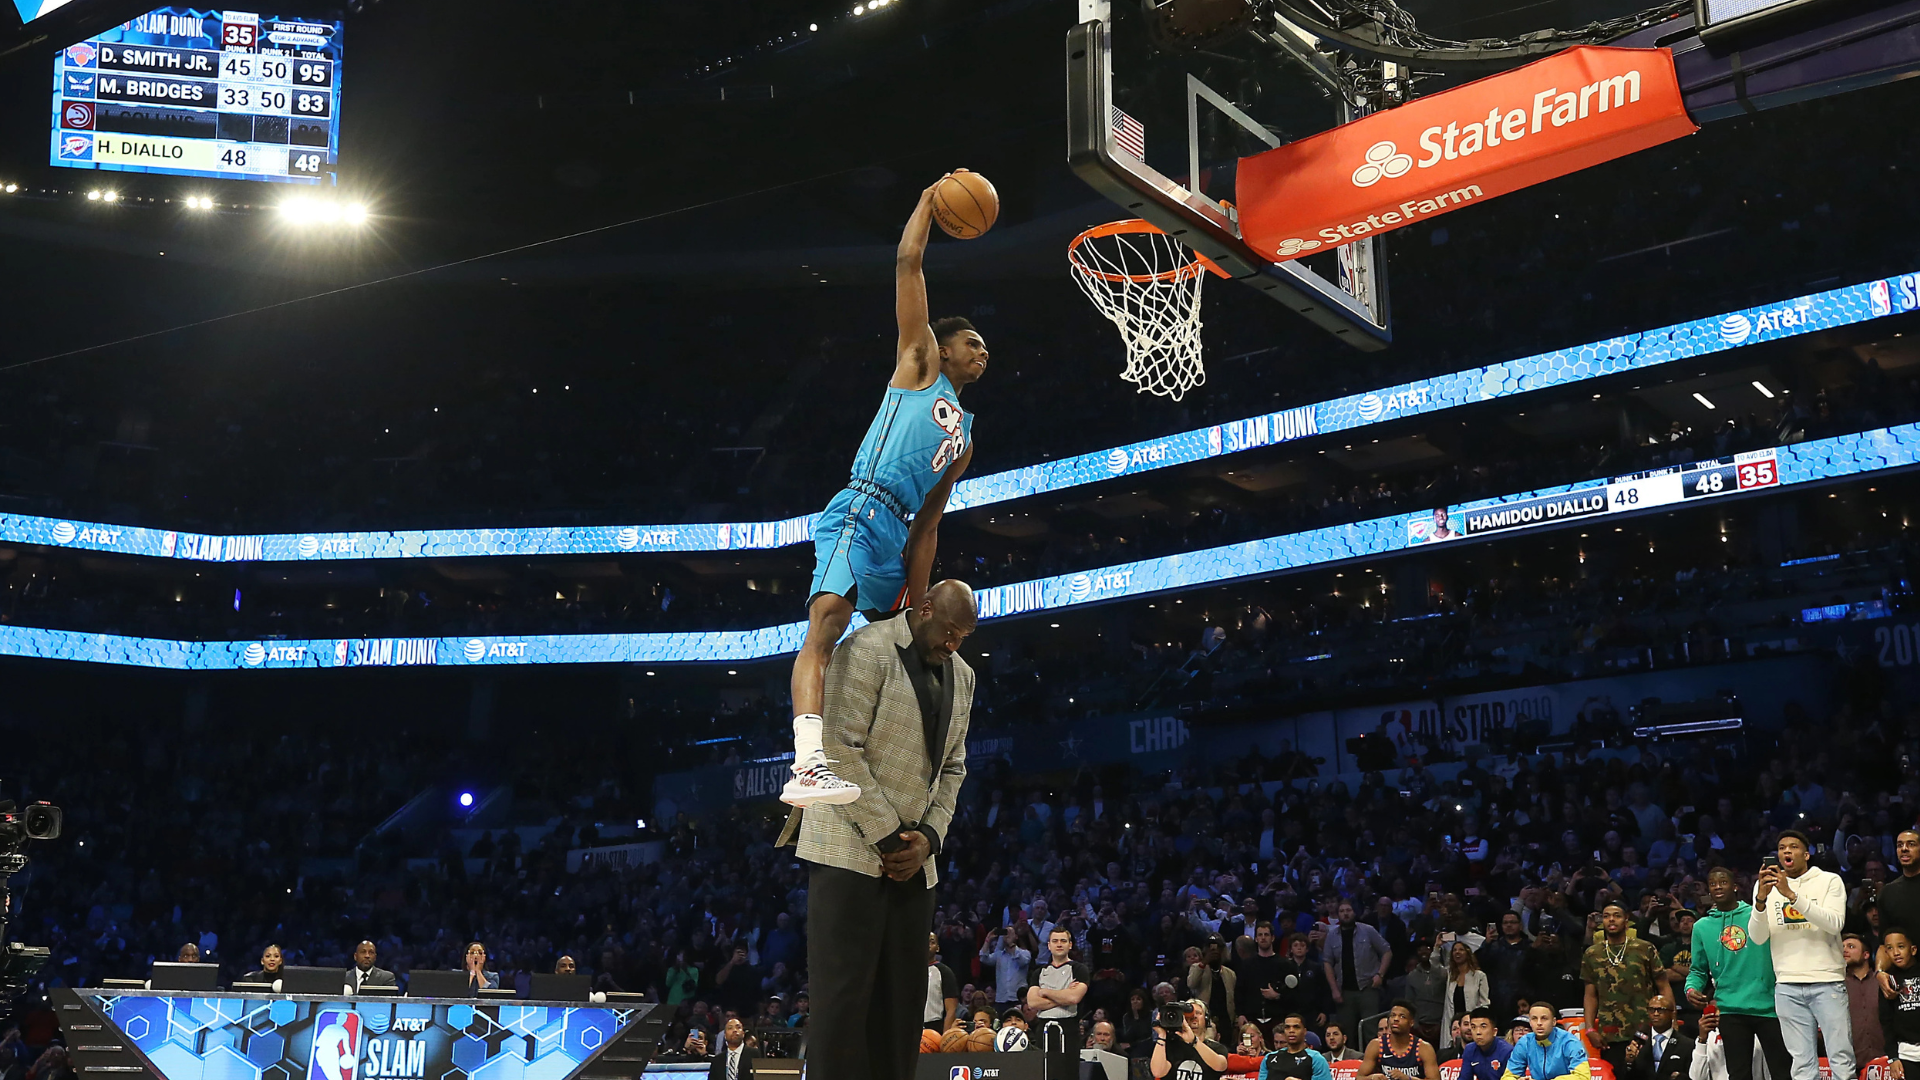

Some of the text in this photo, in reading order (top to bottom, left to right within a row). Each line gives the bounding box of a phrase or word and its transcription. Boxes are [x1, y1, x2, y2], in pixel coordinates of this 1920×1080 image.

[136, 14, 203, 37] SLAM DUNK
[273, 23, 323, 34] FIRST ROUND
[225, 26, 252, 45] 35
[292, 36, 320, 44] ADVANCE
[225, 45, 247, 53] DUNK
[261, 48, 284, 56] DUNK
[301, 51, 326, 60] TOTAL
[101, 47, 117, 63] D.
[122, 50, 181, 69] SMITH
[184, 55, 213, 71] JR.
[225, 59, 250, 76] 45
[262, 61, 287, 78] 50
[299, 64, 326, 83] 95
[100, 78, 203, 101] M. BRIDGES
[224, 88, 249, 106] 33
[261, 91, 285, 109] 50
[297, 94, 324, 112] 83
[98, 140, 183, 159] H. DIALLO
[221, 149, 246, 166] 48
[294, 153, 321, 172] 48
[1756, 305, 1809, 333] AT&T
[1386, 386, 1431, 412] AT&T
[1228, 406, 1318, 451] SLAM DUNK
[1130, 443, 1168, 467] AT&T
[1696, 459, 1721, 469] TOTAL
[1614, 475, 1633, 484] DUNK
[1649, 468, 1668, 478] DUNK
[1740, 462, 1774, 487] 35
[1695, 472, 1724, 493] 48
[1614, 488, 1639, 506] 48
[1469, 495, 1604, 531] HAMIDOU DIALLO
[78, 529, 121, 545] AT&T
[641, 531, 679, 545] AT&T
[736, 517, 810, 548] SLAM DUNK
[182, 535, 264, 560] SLAM DUNK
[321, 538, 358, 552] AT&T
[1094, 570, 1134, 592] AT&T
[1005, 580, 1044, 614] DUNK
[267, 646, 306, 662] AT&T
[353, 639, 438, 665] SLAM DUNK
[488, 642, 528, 657] AT&T
[1775, 901, 1784, 925] GUCCI
[391, 1018, 429, 1032] AT&T
[364, 1038, 426, 1077] SLAM
[983, 1069, 1000, 1078] AT&T
